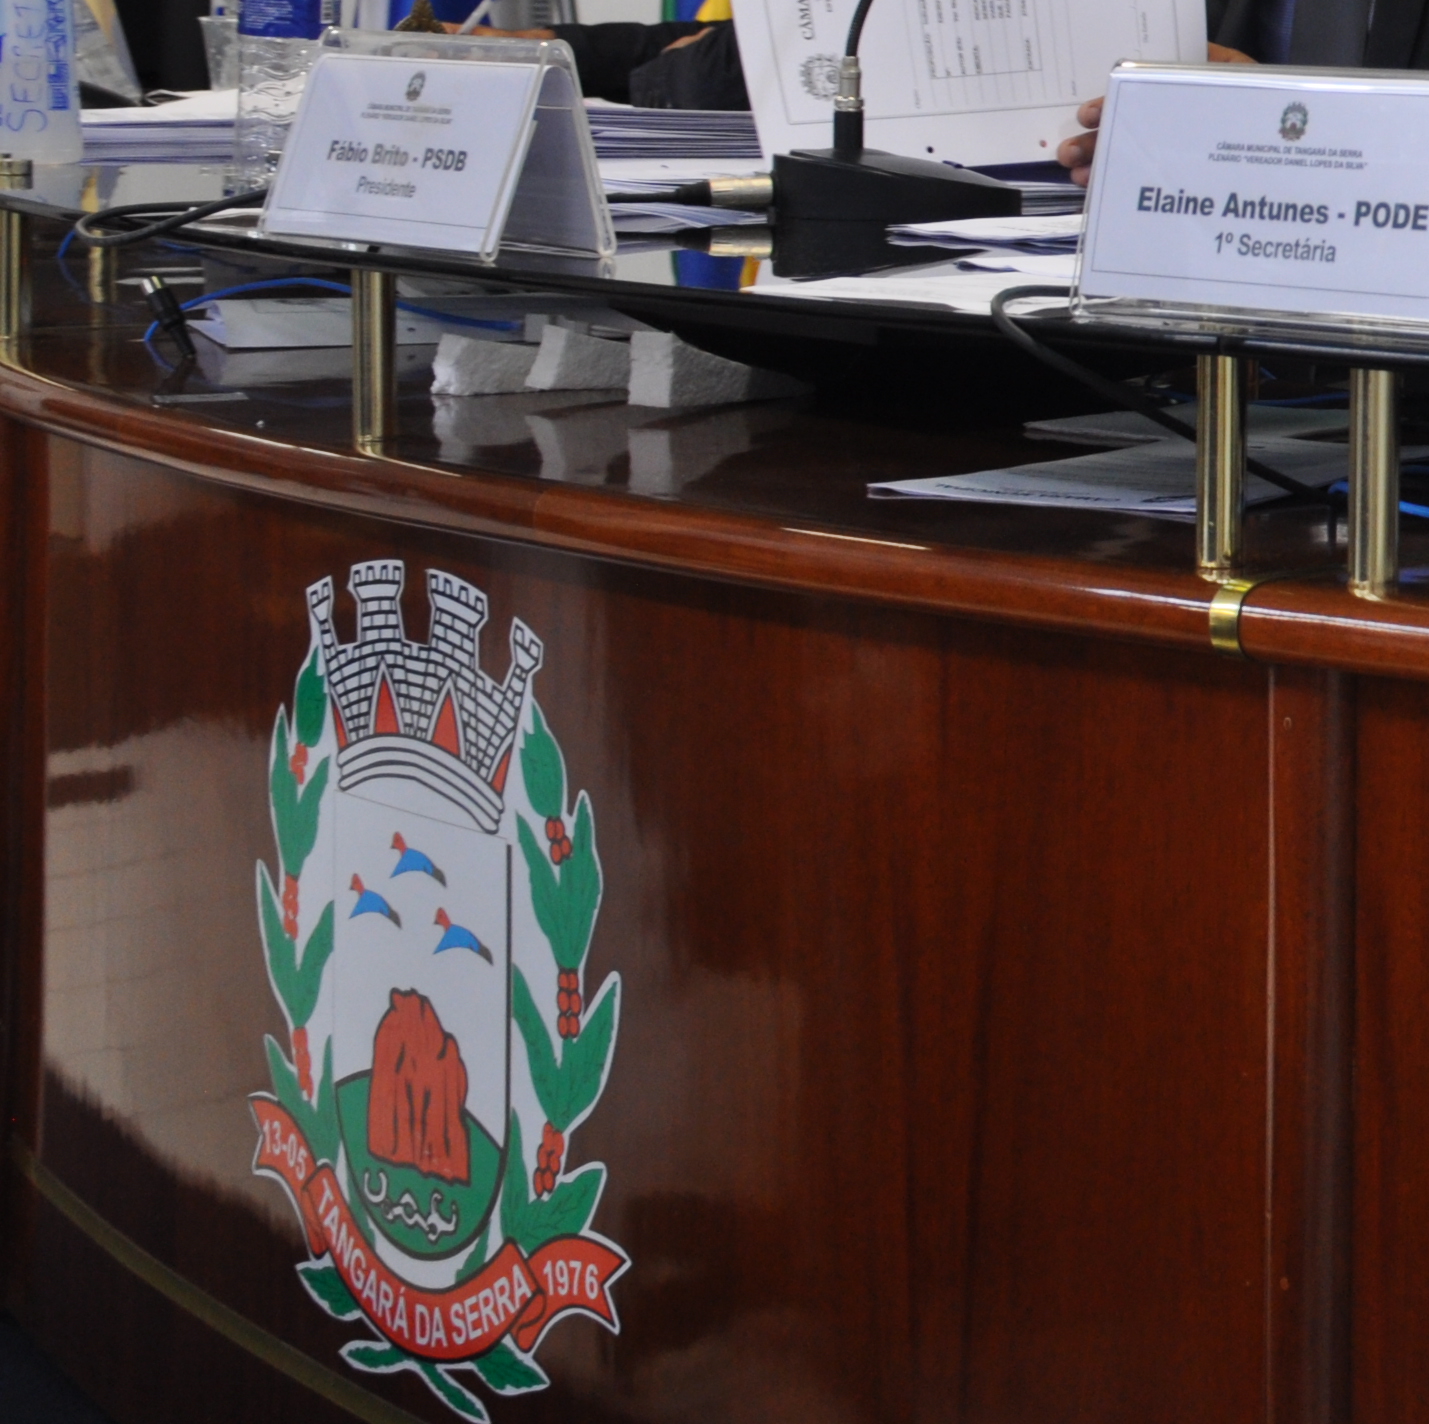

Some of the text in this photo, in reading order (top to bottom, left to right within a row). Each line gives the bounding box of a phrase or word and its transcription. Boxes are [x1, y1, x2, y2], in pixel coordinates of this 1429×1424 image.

[327, 139, 368, 164] Fábio
[371, 143, 410, 167] Brito
[421, 147, 469, 172] PSDB
[356, 175, 416, 199] Presidente
[1136, 186, 1214, 217] Elaine
[1222, 192, 1329, 225] Antunes
[1353, 201, 1429, 231] PODE
[1237, 234, 1336, 264] Secretária
[262, 1118, 308, 1182] 13-05
[318, 1177, 532, 1348] TANGARÁ DA SERRA
[543, 1259, 600, 1301] 1976
